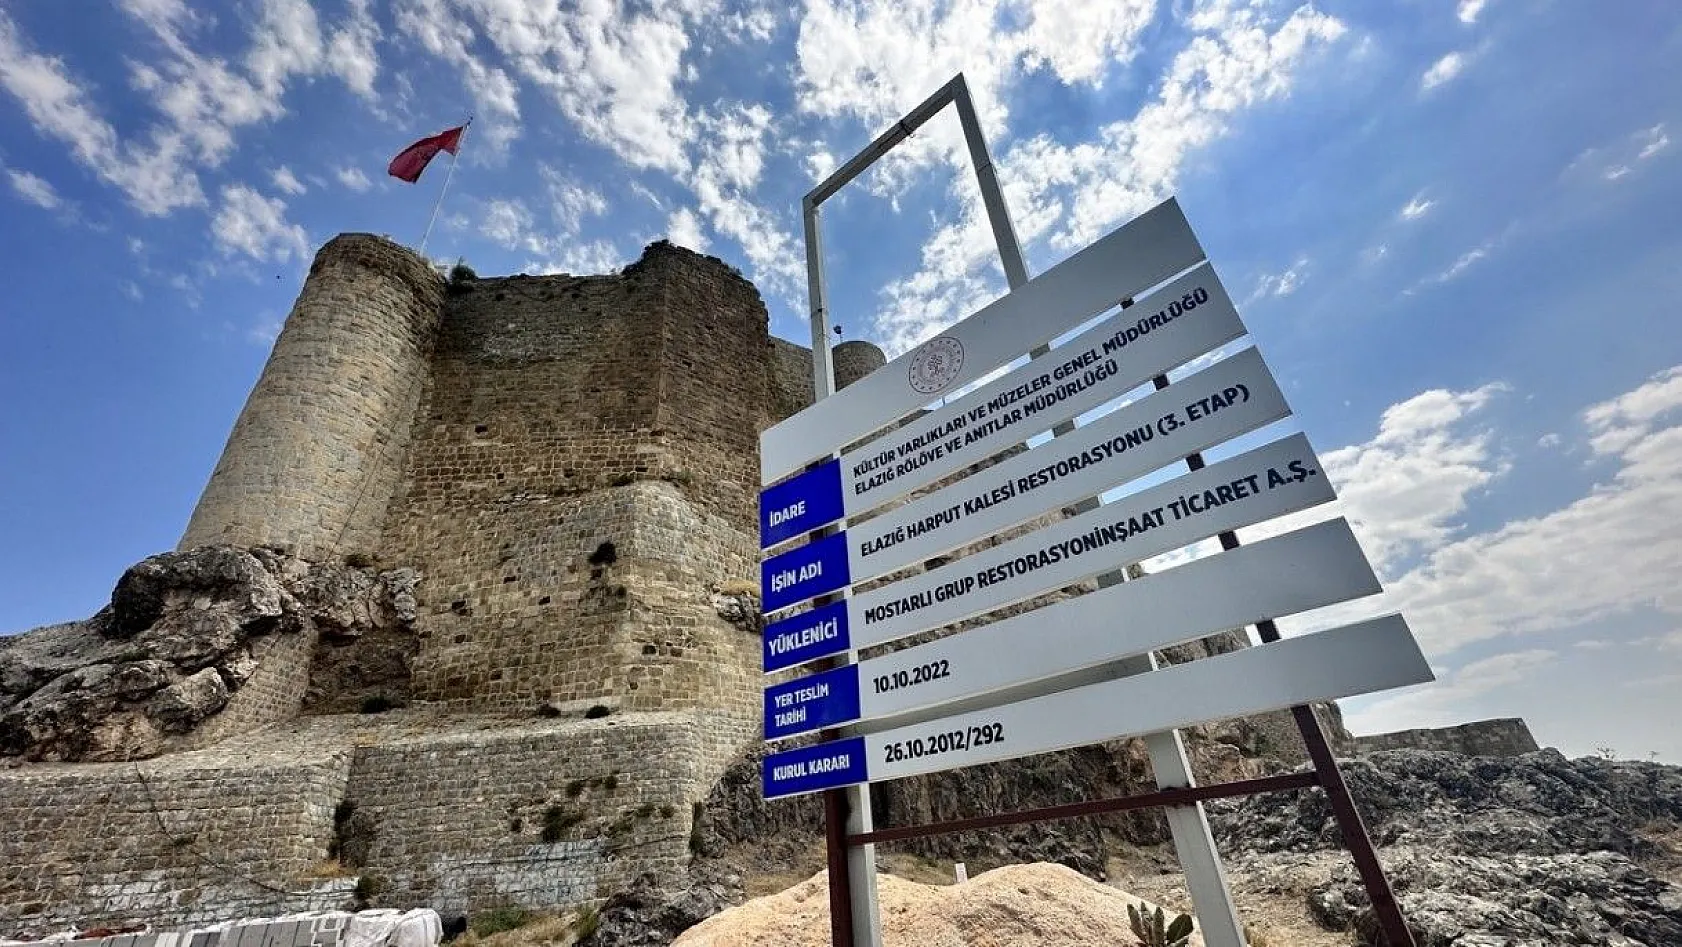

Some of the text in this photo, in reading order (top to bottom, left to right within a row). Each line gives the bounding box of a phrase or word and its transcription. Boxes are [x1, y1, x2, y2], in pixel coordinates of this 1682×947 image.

[853, 287, 1209, 478] KÜLTÜR VARLIKLARI VE MÜZELER GENEL MÜDÜRLÜĞÜ
[854, 360, 1118, 495] ELAZIĞ RÖLÖVE VE ANITLAR MÜDÜRLÜĞÜ
[861, 384, 1249, 557] ELAZIĞ HARPUT KALESİ RESTORASYONU (3. ETAP)
[769, 501, 806, 527] İDARE
[865, 590, 932, 625] MOSTARLI
[934, 576, 975, 602] GRUP
[1167, 474, 1260, 520] TİCARET
[1267, 460, 1317, 490] A.Ş.
[771, 561, 822, 592] İŞİN ADI
[768, 616, 838, 657] YÜKLENİCİ
[774, 683, 830, 708] YER TESLİM
[873, 659, 950, 694] 10.10.2022
[774, 706, 807, 727] TARİHİ
[884, 722, 1005, 763] 26.10.2012/292
[773, 754, 850, 781] KURUL KARARI
